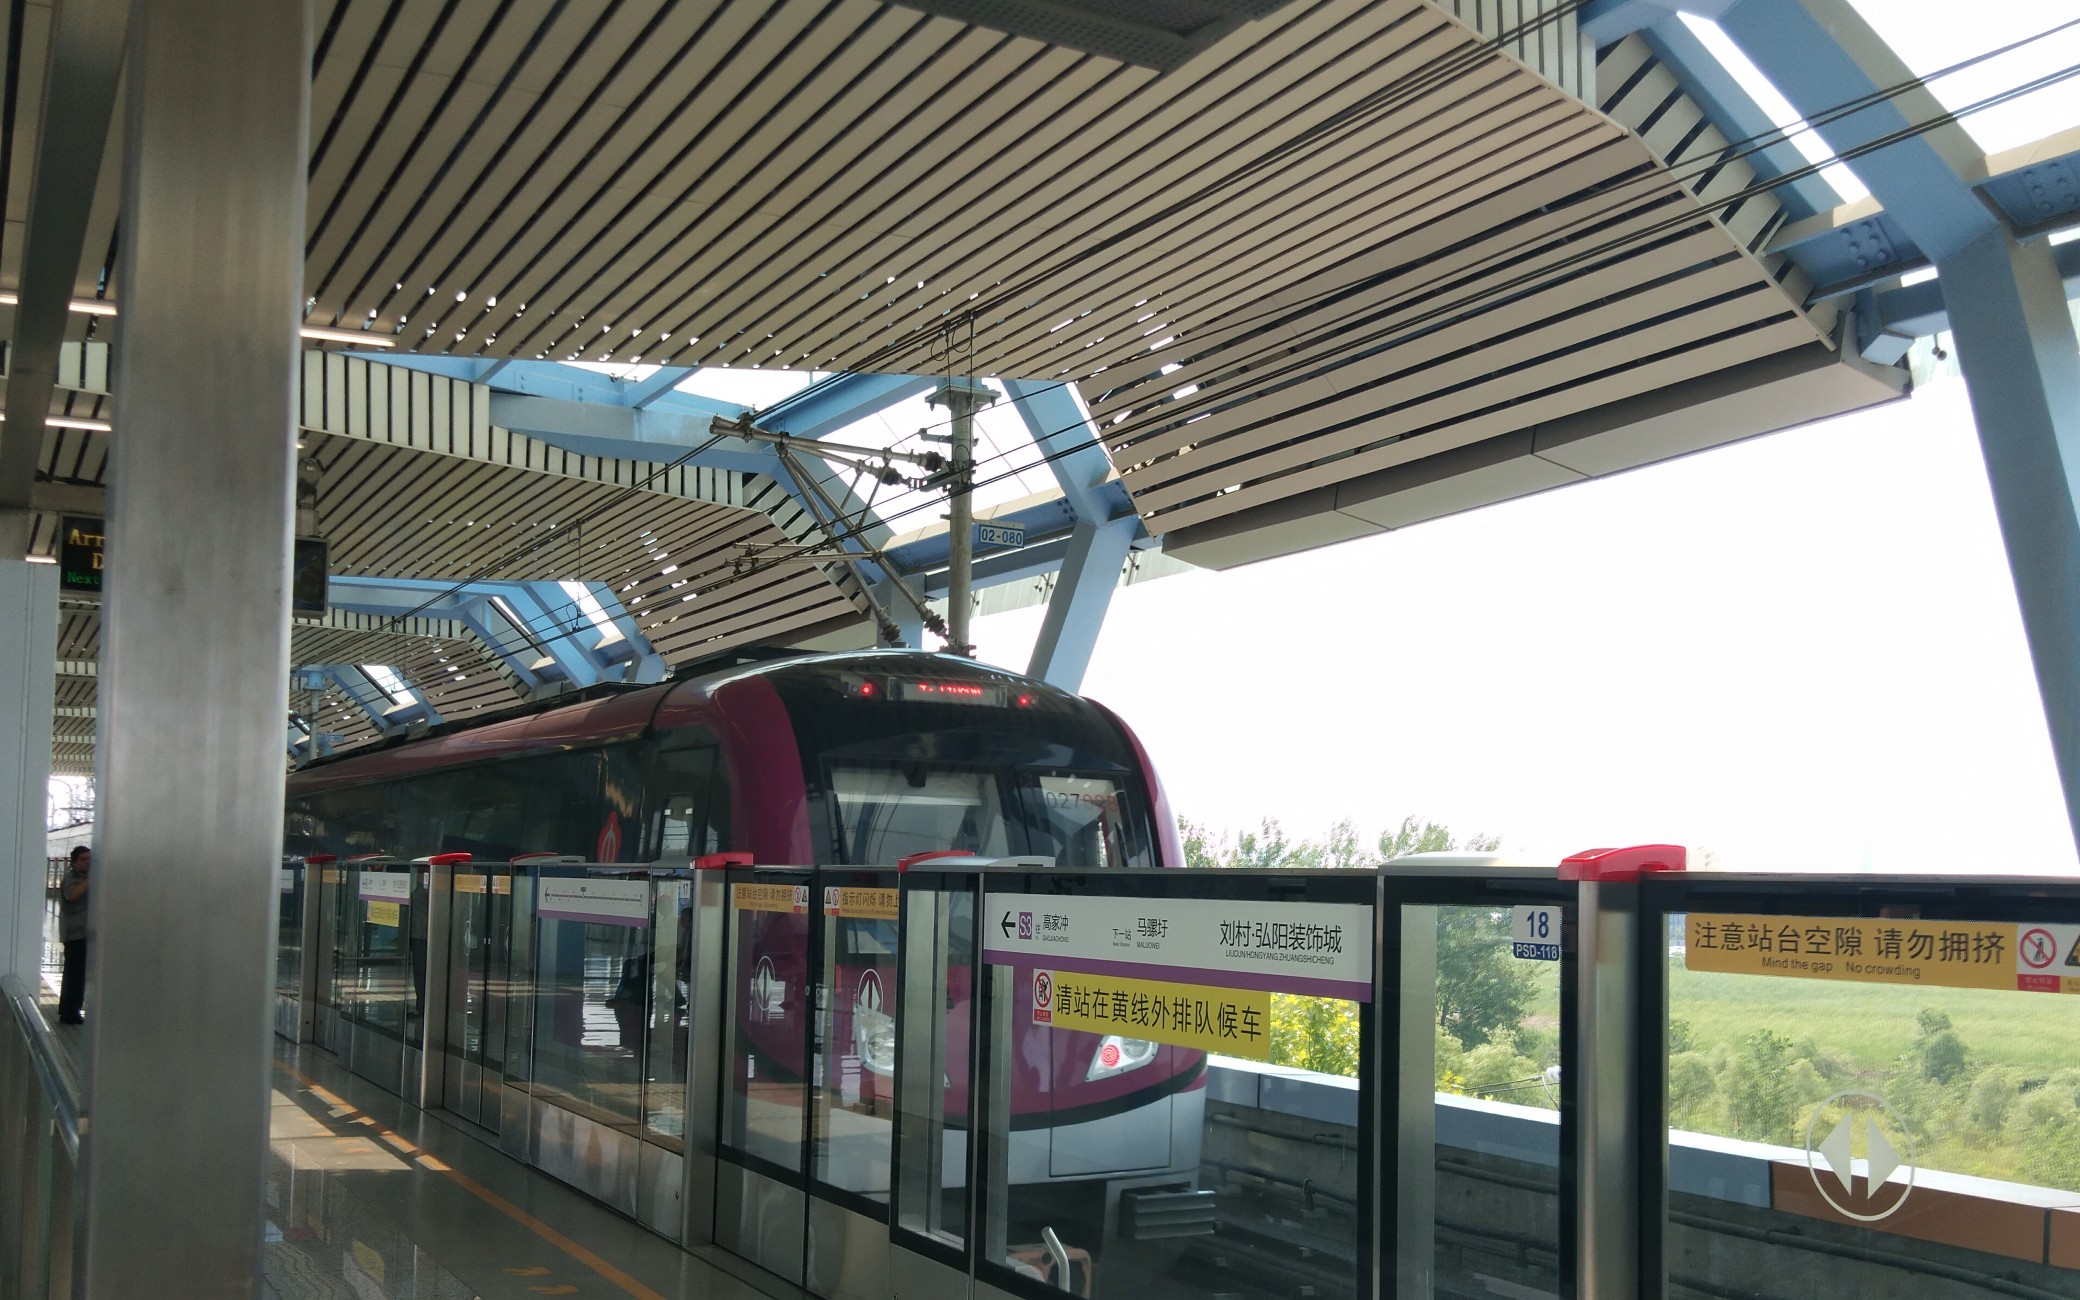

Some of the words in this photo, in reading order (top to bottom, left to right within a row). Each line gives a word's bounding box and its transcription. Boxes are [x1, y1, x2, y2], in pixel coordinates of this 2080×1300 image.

[981, 528, 1023, 545] 02-080
[68, 571, 99, 584] Next
[1019, 915, 1032, 936] S3
[1043, 914, 1069, 932] 高家冲
[1112, 928, 1132, 941] 下一站
[1137, 917, 1168, 938] 马骡圩
[1527, 911, 1549, 938] 18
[1220, 920, 1342, 953] 刘村·弘阳装饰城
[1694, 921, 1862, 956] 注意站台空隙
[1874, 928, 2005, 964] 请勿拥挤
[1516, 944, 1558, 959] PSD-118
[1761, 957, 1788, 968] Mind
[1790, 958, 1808, 970] the
[1811, 961, 1833, 972] gap
[1846, 962, 1862, 973] No
[1864, 963, 1921, 979] crowding
[1056, 984, 1262, 1041] 请站在黄线外排队候车
